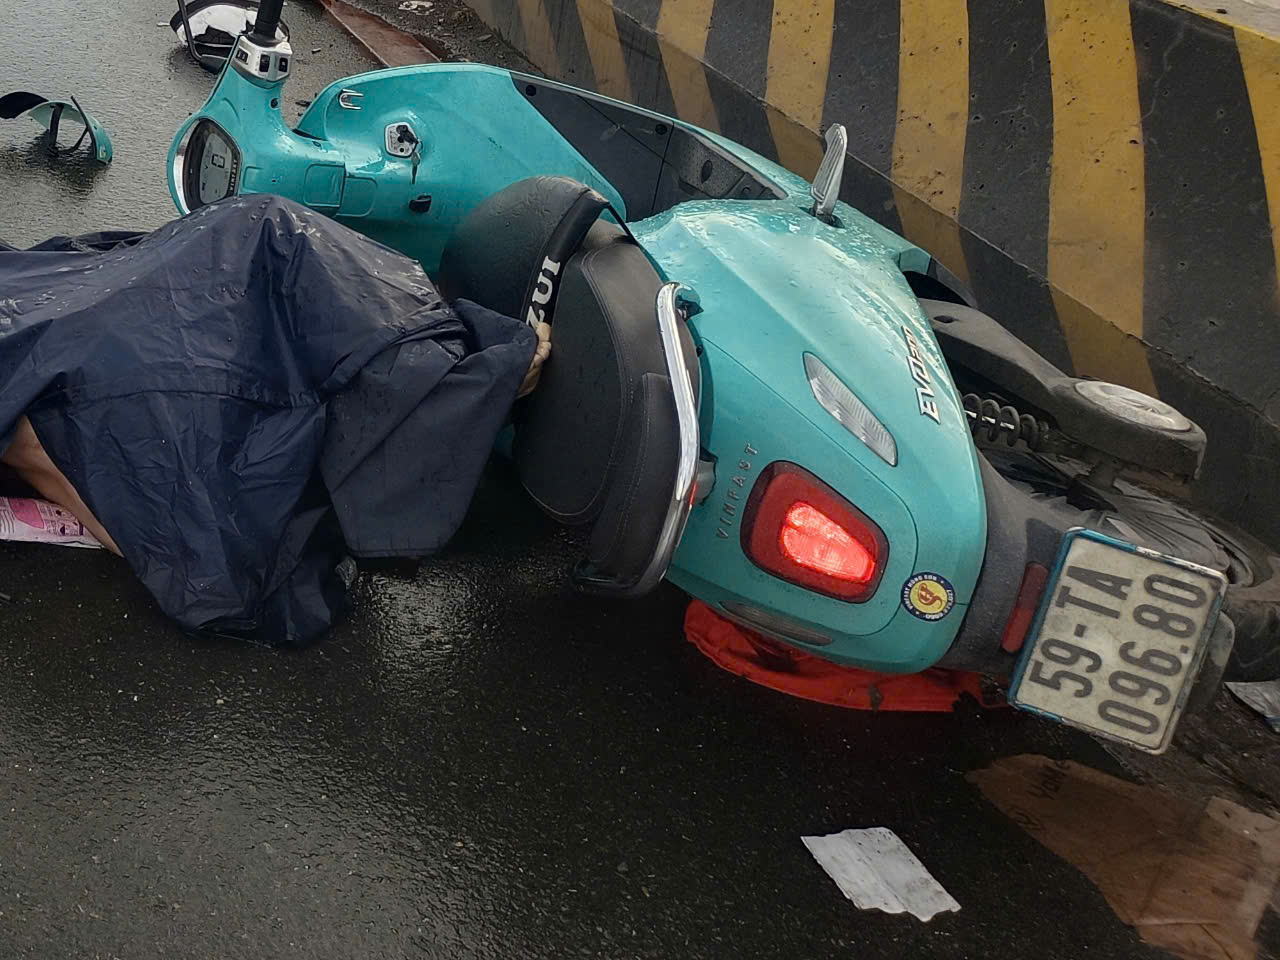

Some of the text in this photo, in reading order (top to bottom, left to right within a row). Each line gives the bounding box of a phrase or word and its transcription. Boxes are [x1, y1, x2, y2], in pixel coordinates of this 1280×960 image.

[716, 442, 758, 539] VINFAST
[1028, 565, 1133, 698] 59-TA
[1097, 573, 1206, 735] 096.80
